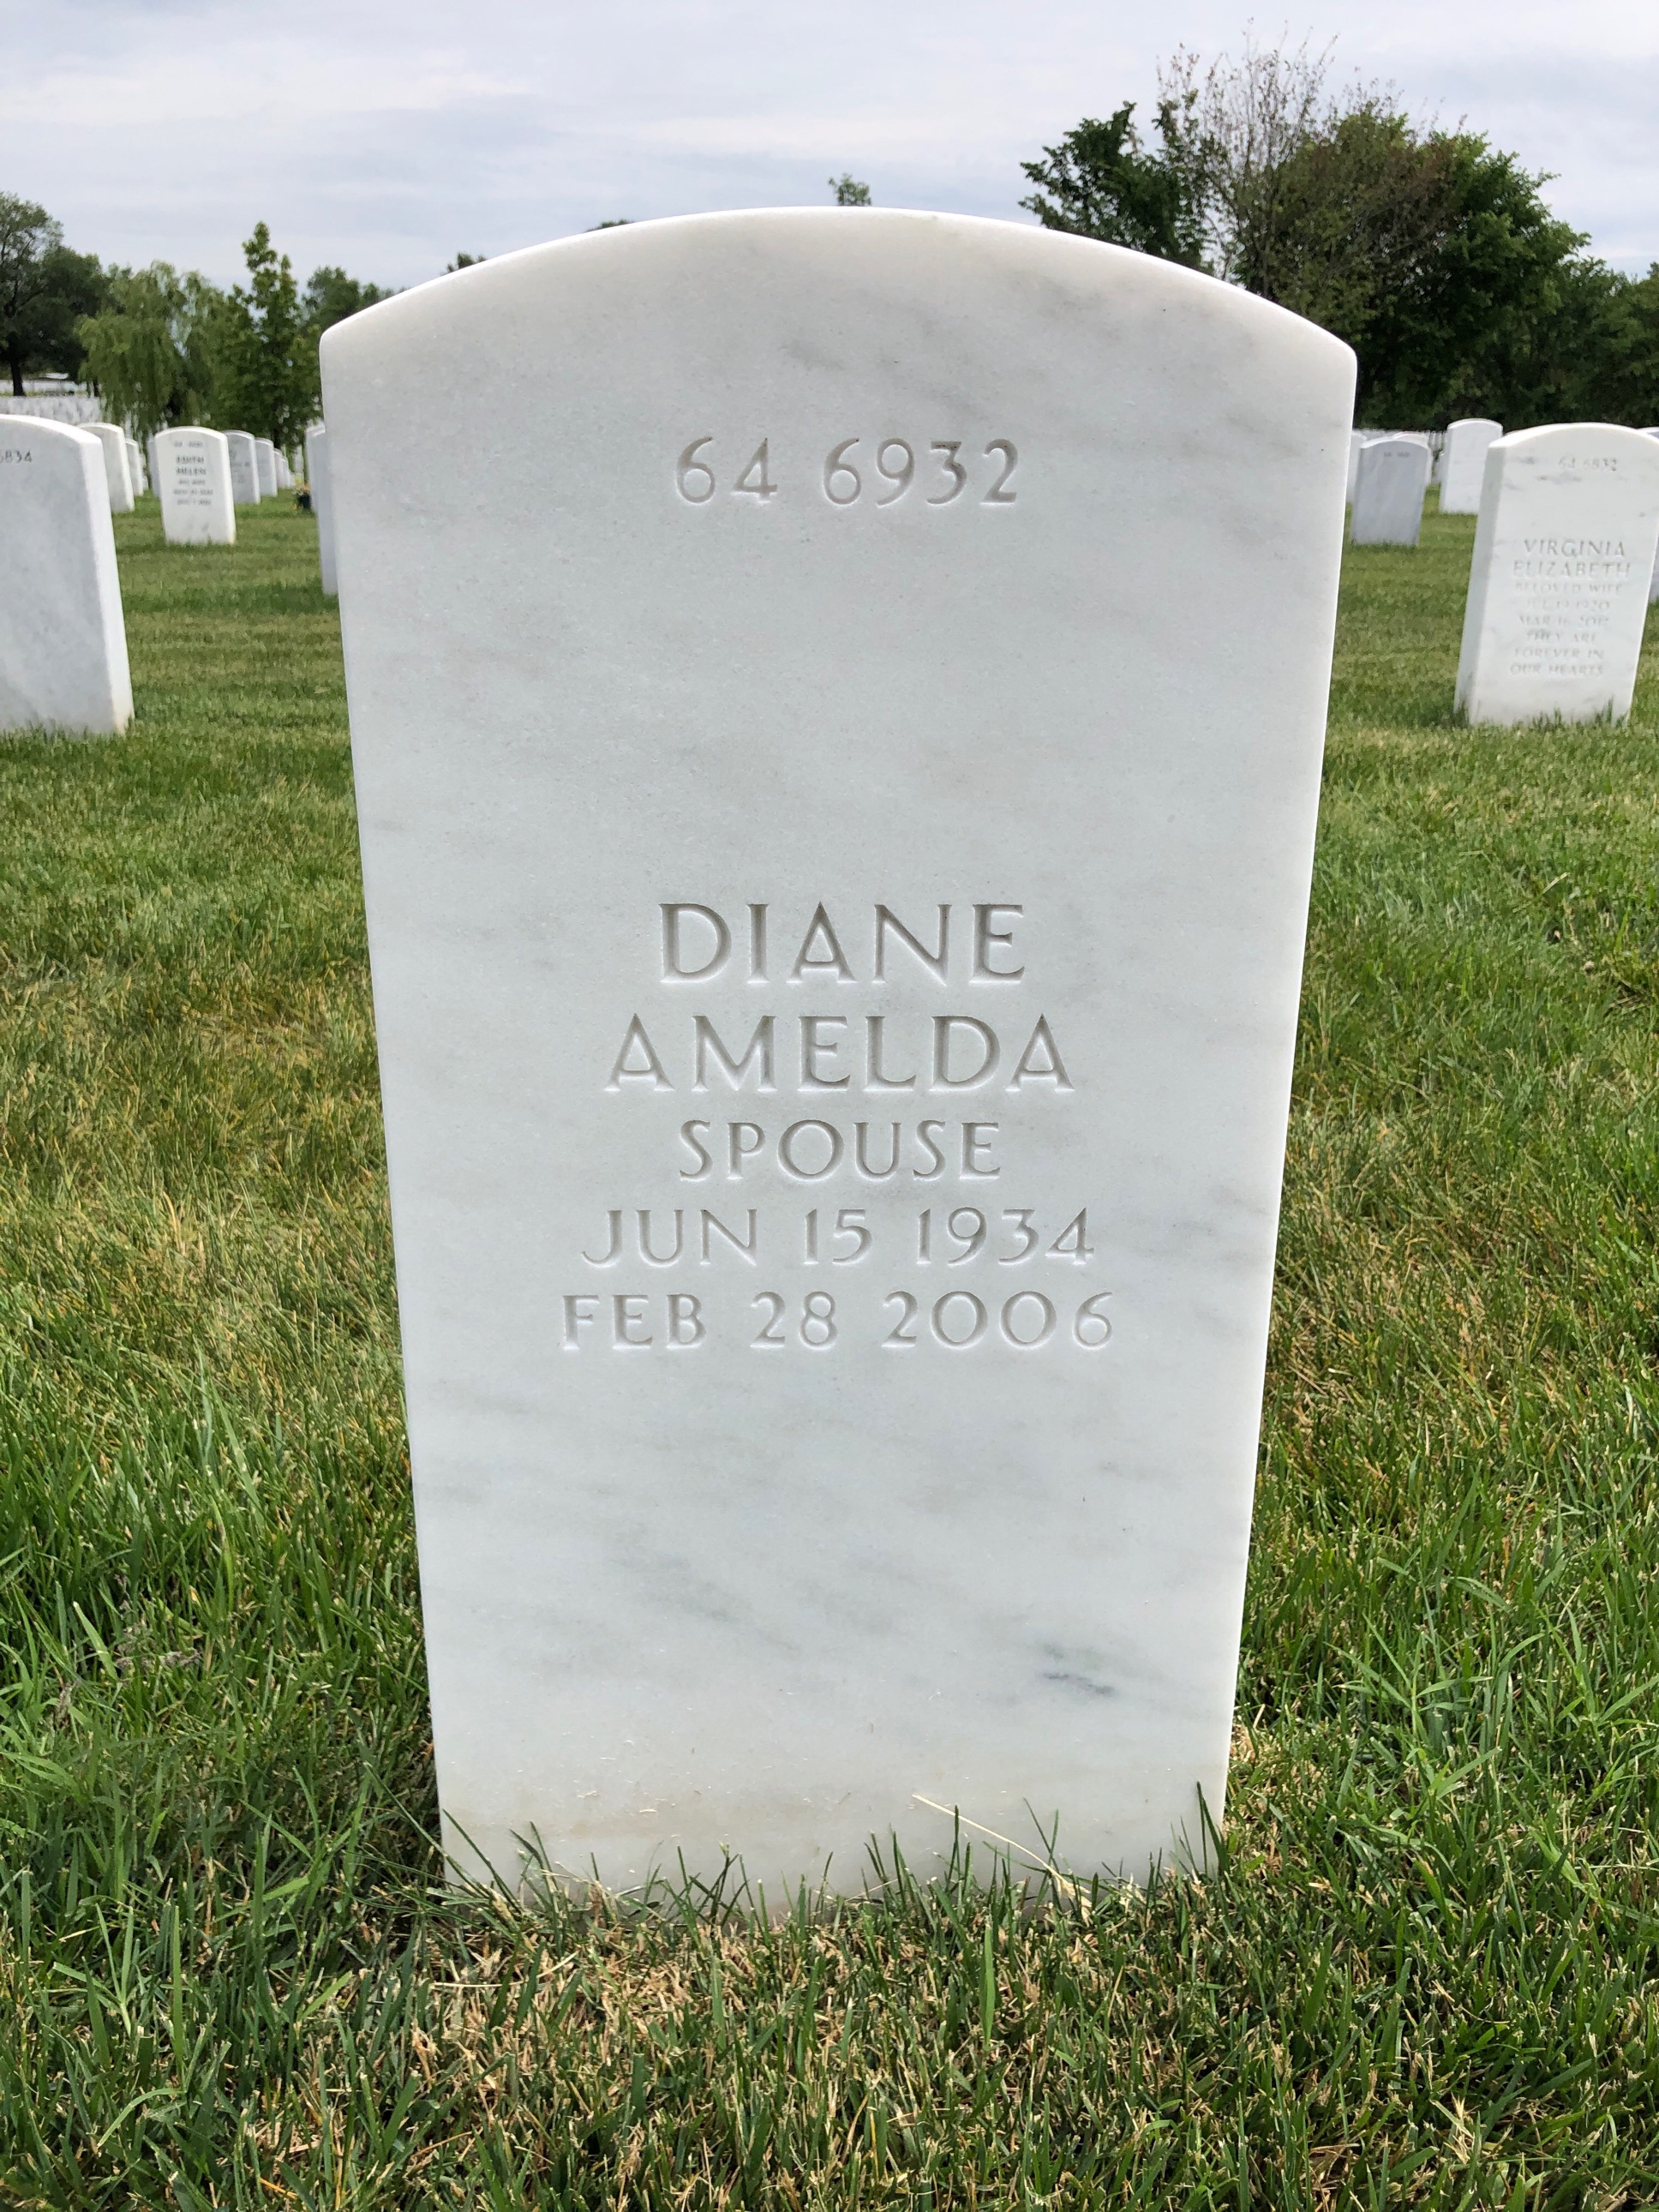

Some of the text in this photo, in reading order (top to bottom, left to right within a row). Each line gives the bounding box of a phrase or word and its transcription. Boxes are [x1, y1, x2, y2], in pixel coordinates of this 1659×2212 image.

[675, 435, 1019, 508] 64 6932
[1512, 559, 1632, 579] ELIZABETH
[1524, 537, 1626, 559] VIRGINIA
[1514, 581, 1624, 596] BELOVED WIFE
[1509, 662, 1604, 676] OUR HEARTS
[1513, 646, 1605, 661] FOREVER IN
[658, 901, 1027, 986] DIANE
[603, 1012, 1076, 1093] AMELDA
[678, 1119, 1002, 1182] SPOUSE
[581, 1206, 1095, 1268] JUN 15 1934
[560, 1291, 1114, 1351] FEB 28 2006
